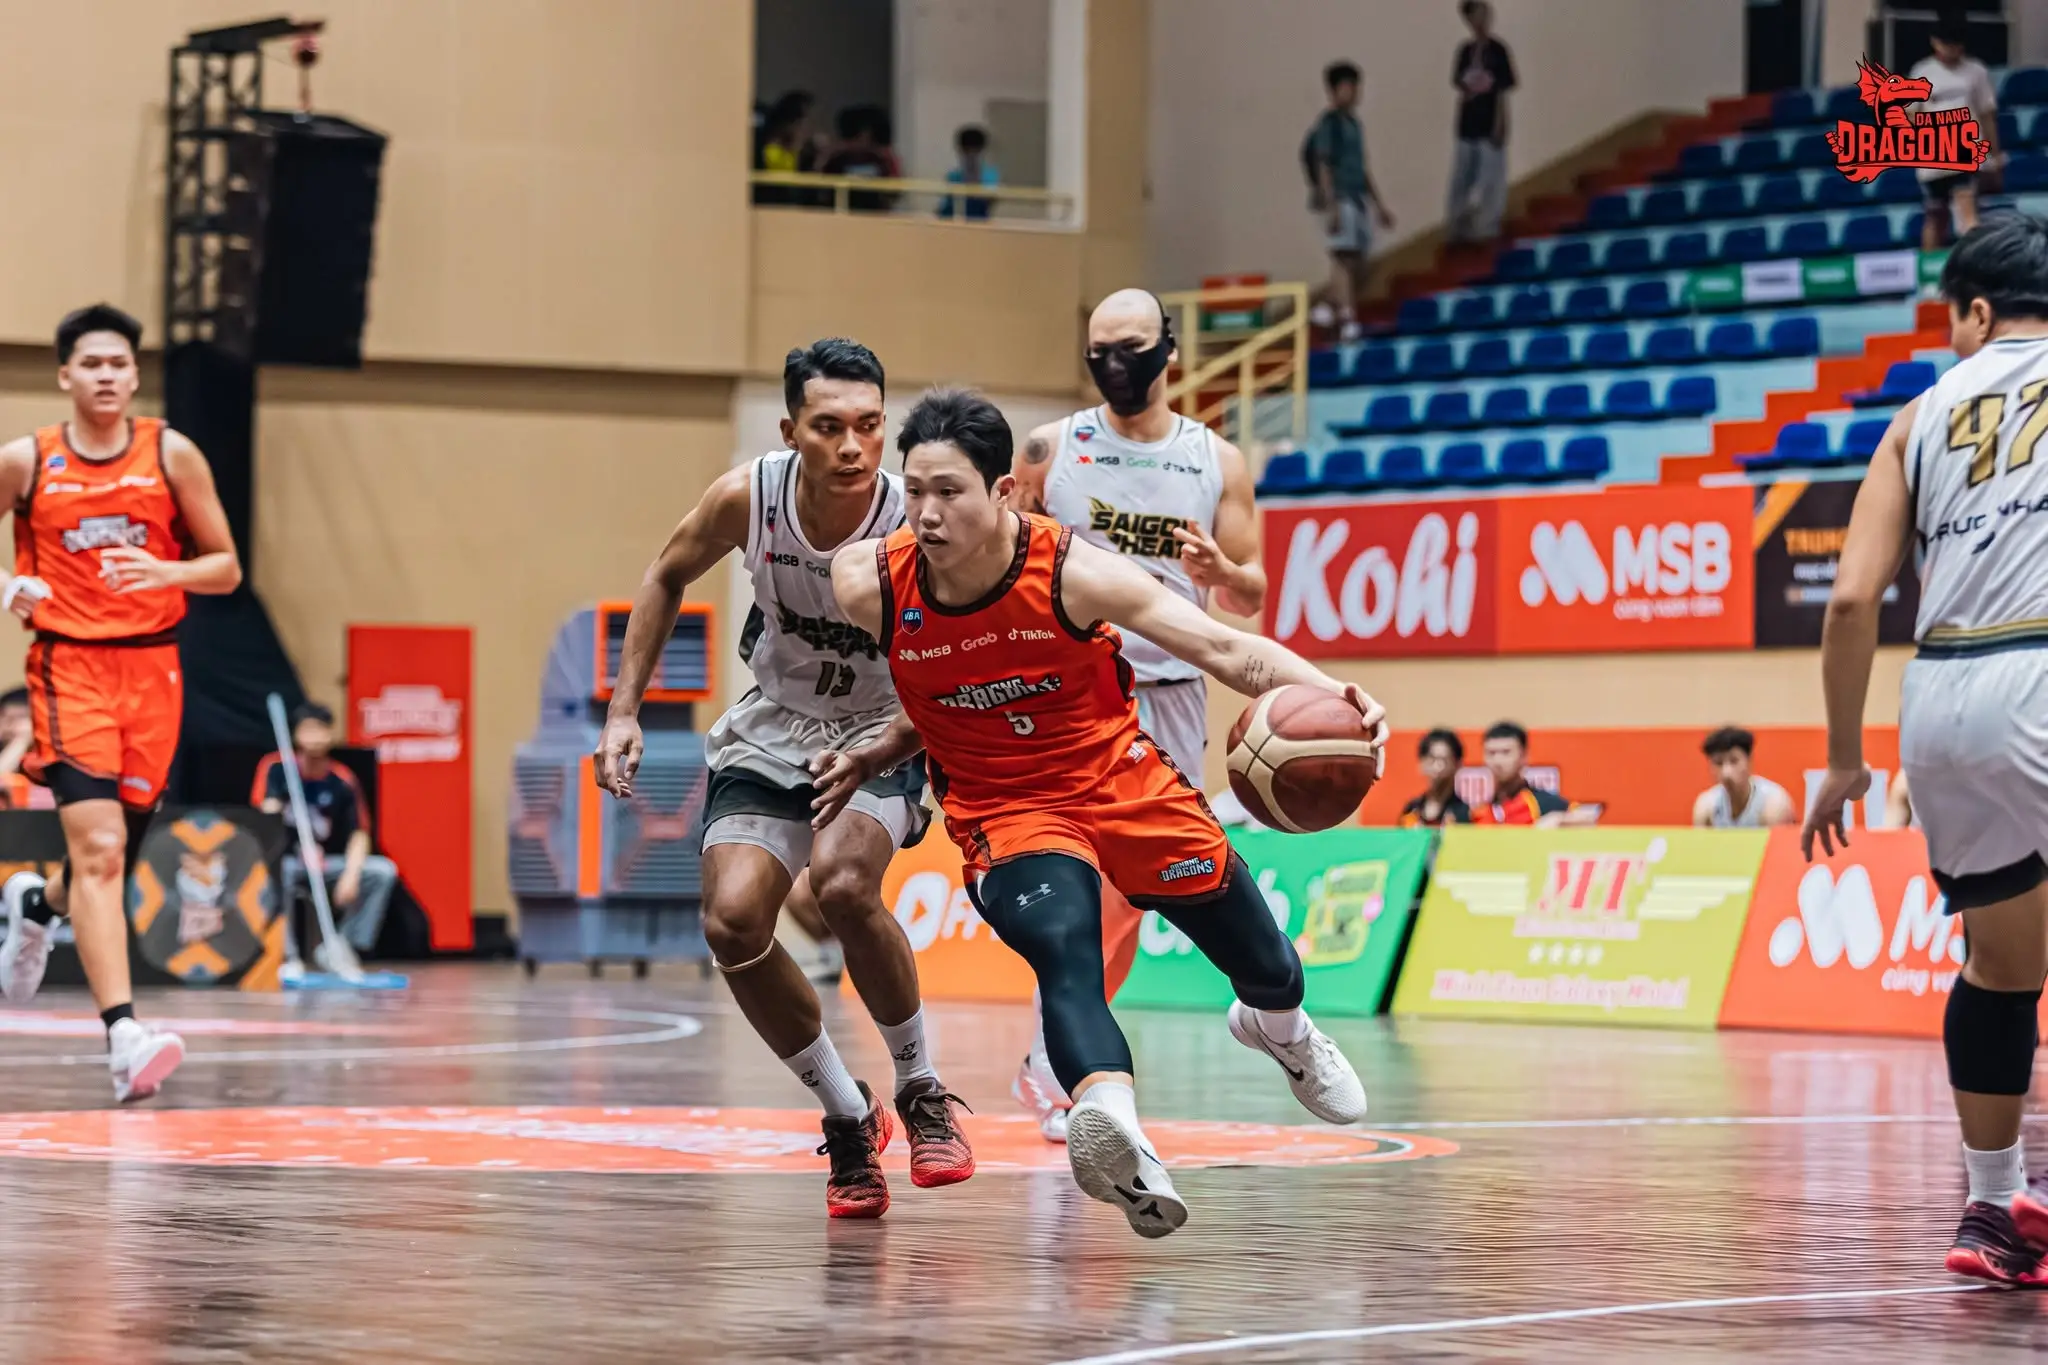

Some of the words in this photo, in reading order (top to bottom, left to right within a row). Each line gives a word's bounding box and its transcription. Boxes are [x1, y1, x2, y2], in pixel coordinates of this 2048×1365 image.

[1948, 377, 2048, 489] 47
[1095, 455, 1120, 466] MSB
[1126, 457, 1157, 469] Grab
[772, 552, 800, 567] MSB
[805, 560, 832, 579] Gra
[1612, 521, 1732, 596] MSB
[1274, 511, 1478, 641] Kohi
[904, 611, 921, 621] VBA
[921, 644, 952, 660] MSB
[960, 631, 998, 652] Grab
[1021, 629, 1056, 642] TikTok
[1004, 710, 1036, 736] 5
[1160, 858, 1215, 882] DRAGONS
